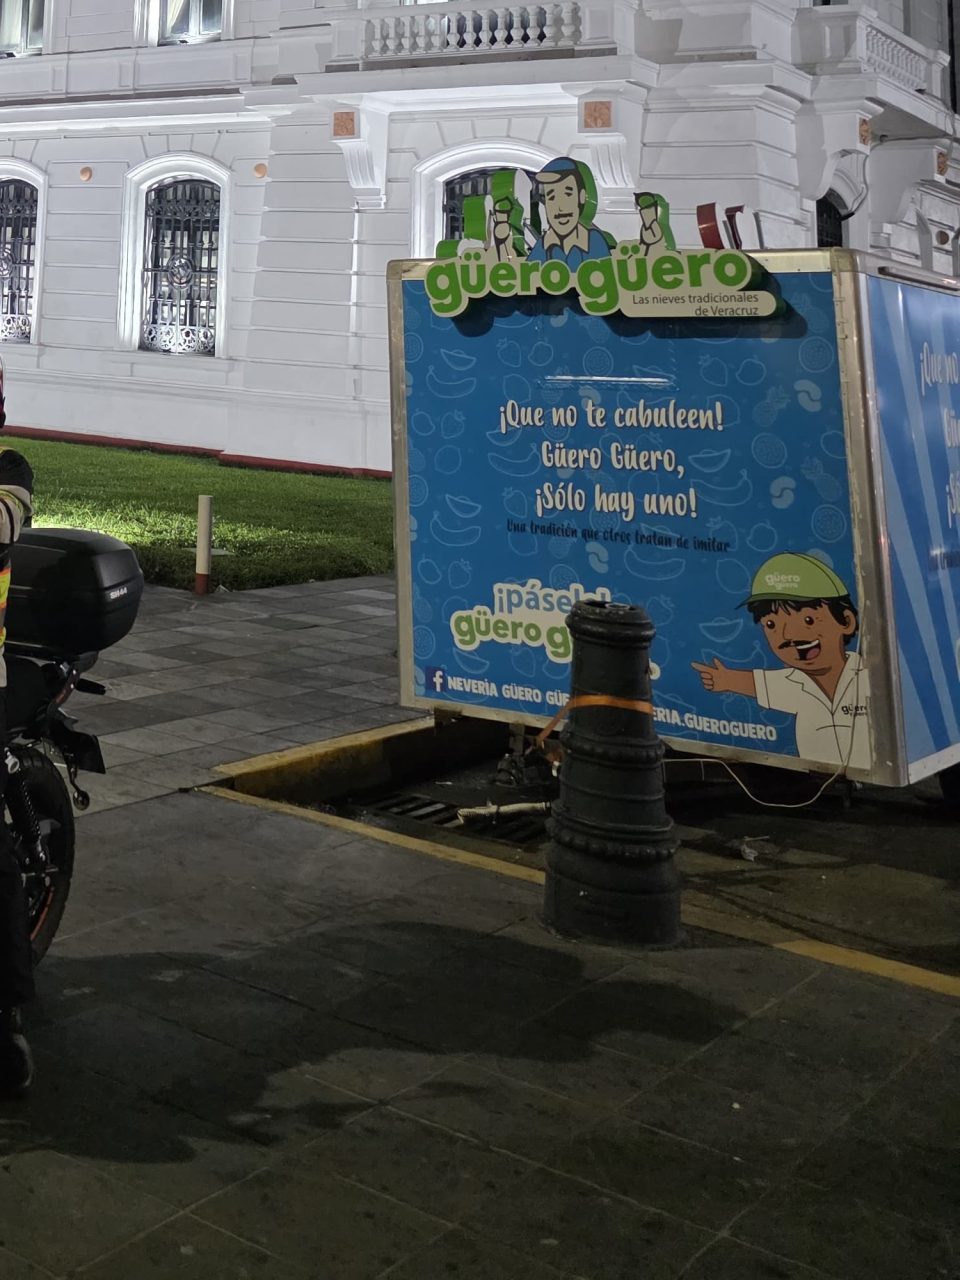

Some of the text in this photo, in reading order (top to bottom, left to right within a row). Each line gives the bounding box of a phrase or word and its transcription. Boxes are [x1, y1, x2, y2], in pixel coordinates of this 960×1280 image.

[427, 244, 749, 313] güero güero
[632, 292, 759, 305] Las nieves tradicionales
[694, 306, 759, 317] de Veracruz
[499, 399, 724, 434] ¡Que no te cabuleen!
[541, 440, 685, 480] Güero Güero,
[535, 482, 698, 522] ¡Sólo hay uno!
[506, 519, 731, 553] Una tradición que otros tratan de imitar
[497, 583, 607, 614] ¡páse
[454, 609, 542, 646] güero
[501, 683, 542, 703] GÜERO
[652, 706, 777, 742] ERIA.GUEROGUERO
